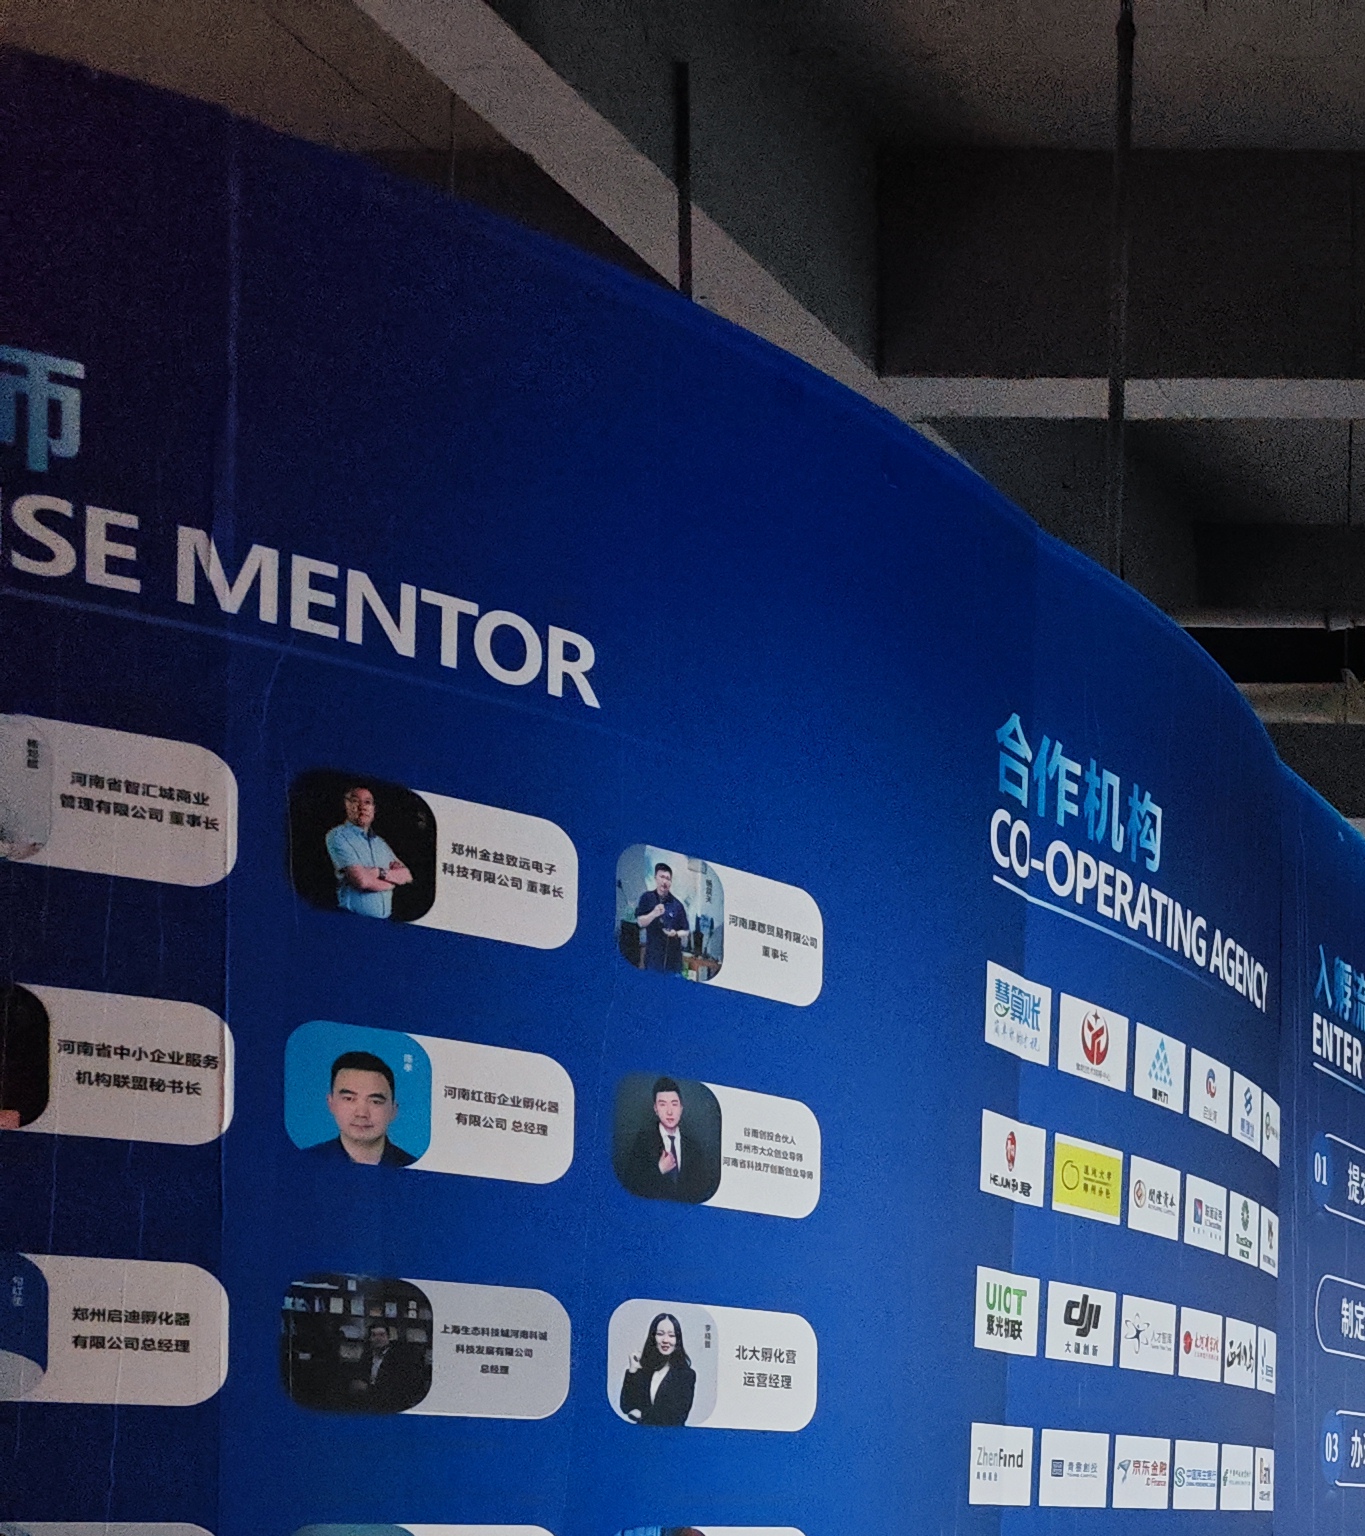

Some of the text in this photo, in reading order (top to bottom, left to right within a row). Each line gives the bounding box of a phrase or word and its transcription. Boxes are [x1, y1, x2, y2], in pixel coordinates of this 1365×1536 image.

[10, 493, 602, 710] SE MENTOR
[69, 771, 211, 807] 河南省智汇城商业
[995, 712, 1163, 873] 合作机构
[168, 810, 220, 831] 董事长
[441, 862, 565, 899] 科技有限公司 董事长
[989, 808, 1269, 1013] CO-OPERATING AGENCY
[57, 1039, 219, 1070] 河南省中小企业服务
[1312, 1012, 1363, 1080] ENTER
[75, 1069, 202, 1096] 机构联盟秘书长
[454, 1112, 549, 1137] 有限公司 总经理
[1313, 1152, 1328, 1185] 01
[71, 1306, 191, 1327] 郑州启迪孵化器
[71, 1334, 191, 1354] 有限公司总经理
[1325, 1431, 1339, 1463] 03
